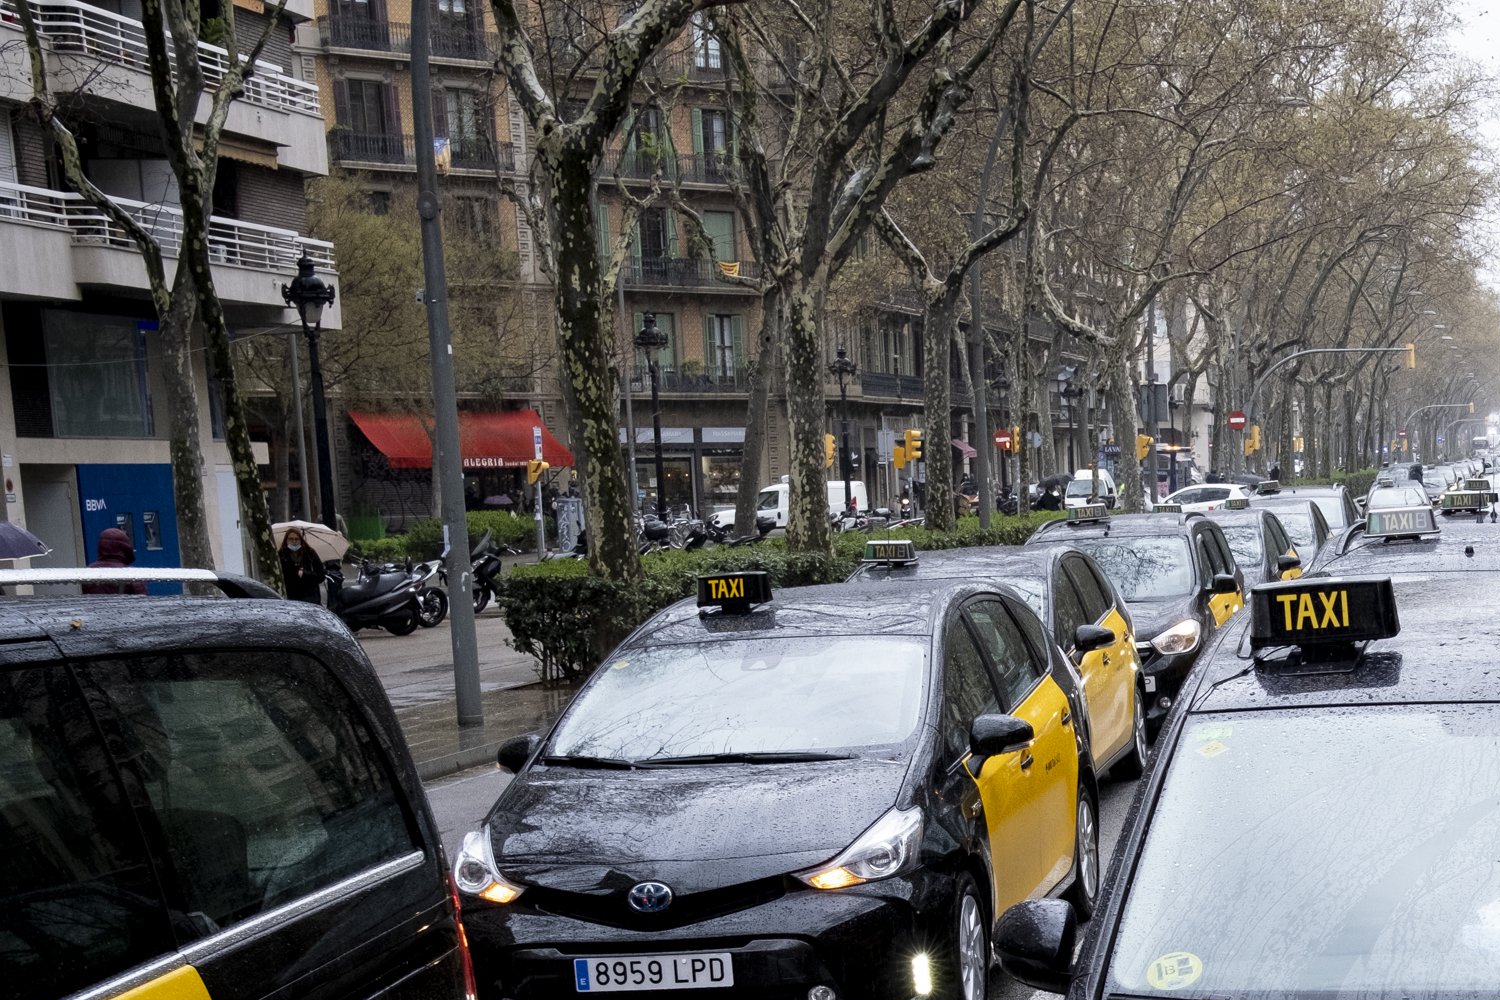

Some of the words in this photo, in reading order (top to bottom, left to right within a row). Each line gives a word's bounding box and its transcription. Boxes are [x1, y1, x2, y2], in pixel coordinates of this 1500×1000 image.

[85, 498, 107, 511] BBVA
[1453, 495, 1472, 506] TAXI
[1077, 507, 1094, 517] TAXI
[1383, 512, 1414, 531] TAXI
[874, 545, 896, 558] TAXI
[708, 578, 745, 599] TAXI
[1276, 590, 1350, 632] TAXI
[580, 978, 587, 986] E
[595, 960, 663, 986] 8959
[673, 957, 725, 984] LPD
